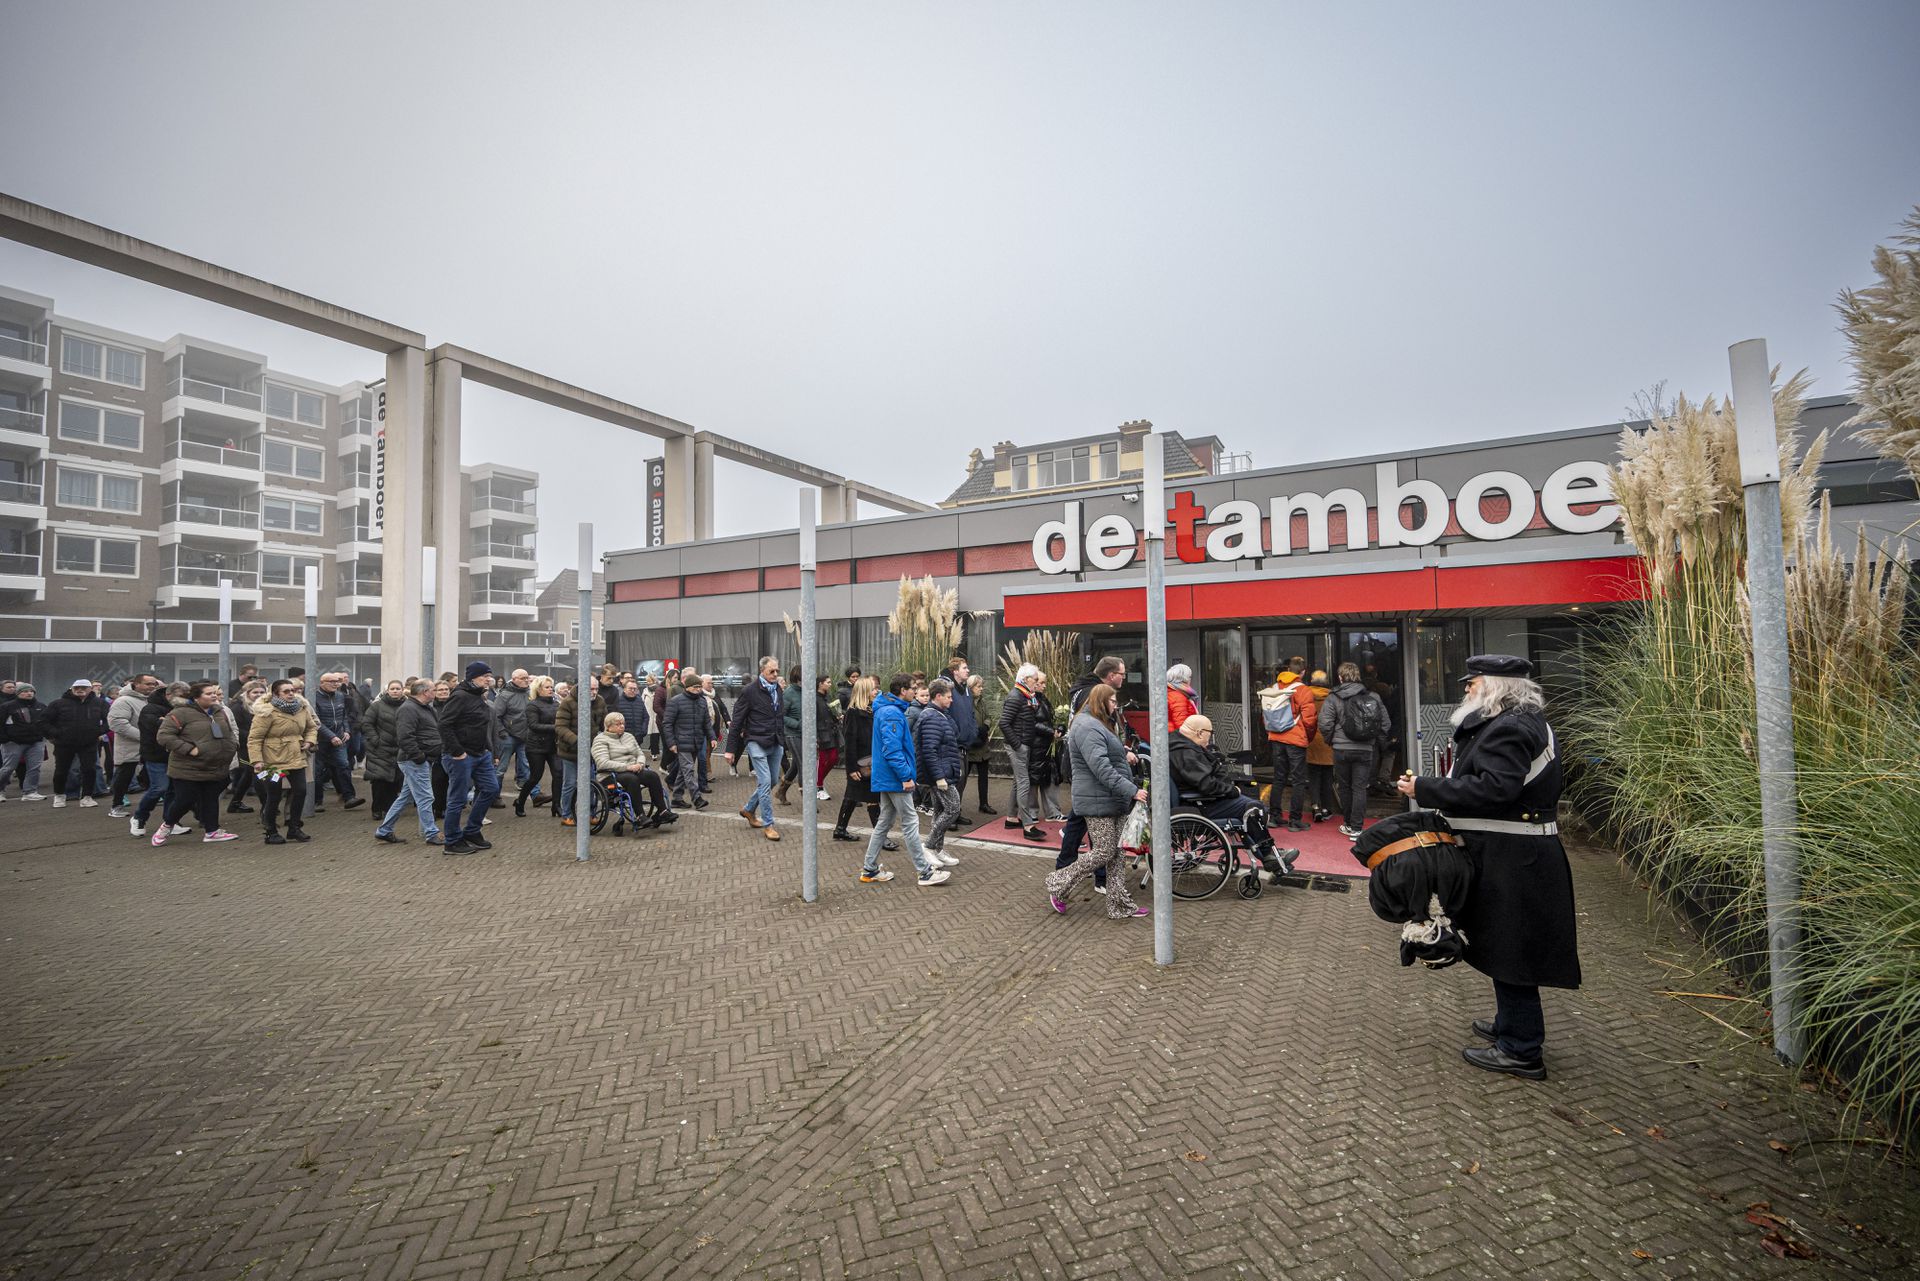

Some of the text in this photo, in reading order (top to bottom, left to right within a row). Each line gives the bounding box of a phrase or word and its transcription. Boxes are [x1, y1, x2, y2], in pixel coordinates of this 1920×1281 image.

[653, 465, 664, 487] de
[1032, 460, 1623, 575] de tamboe
